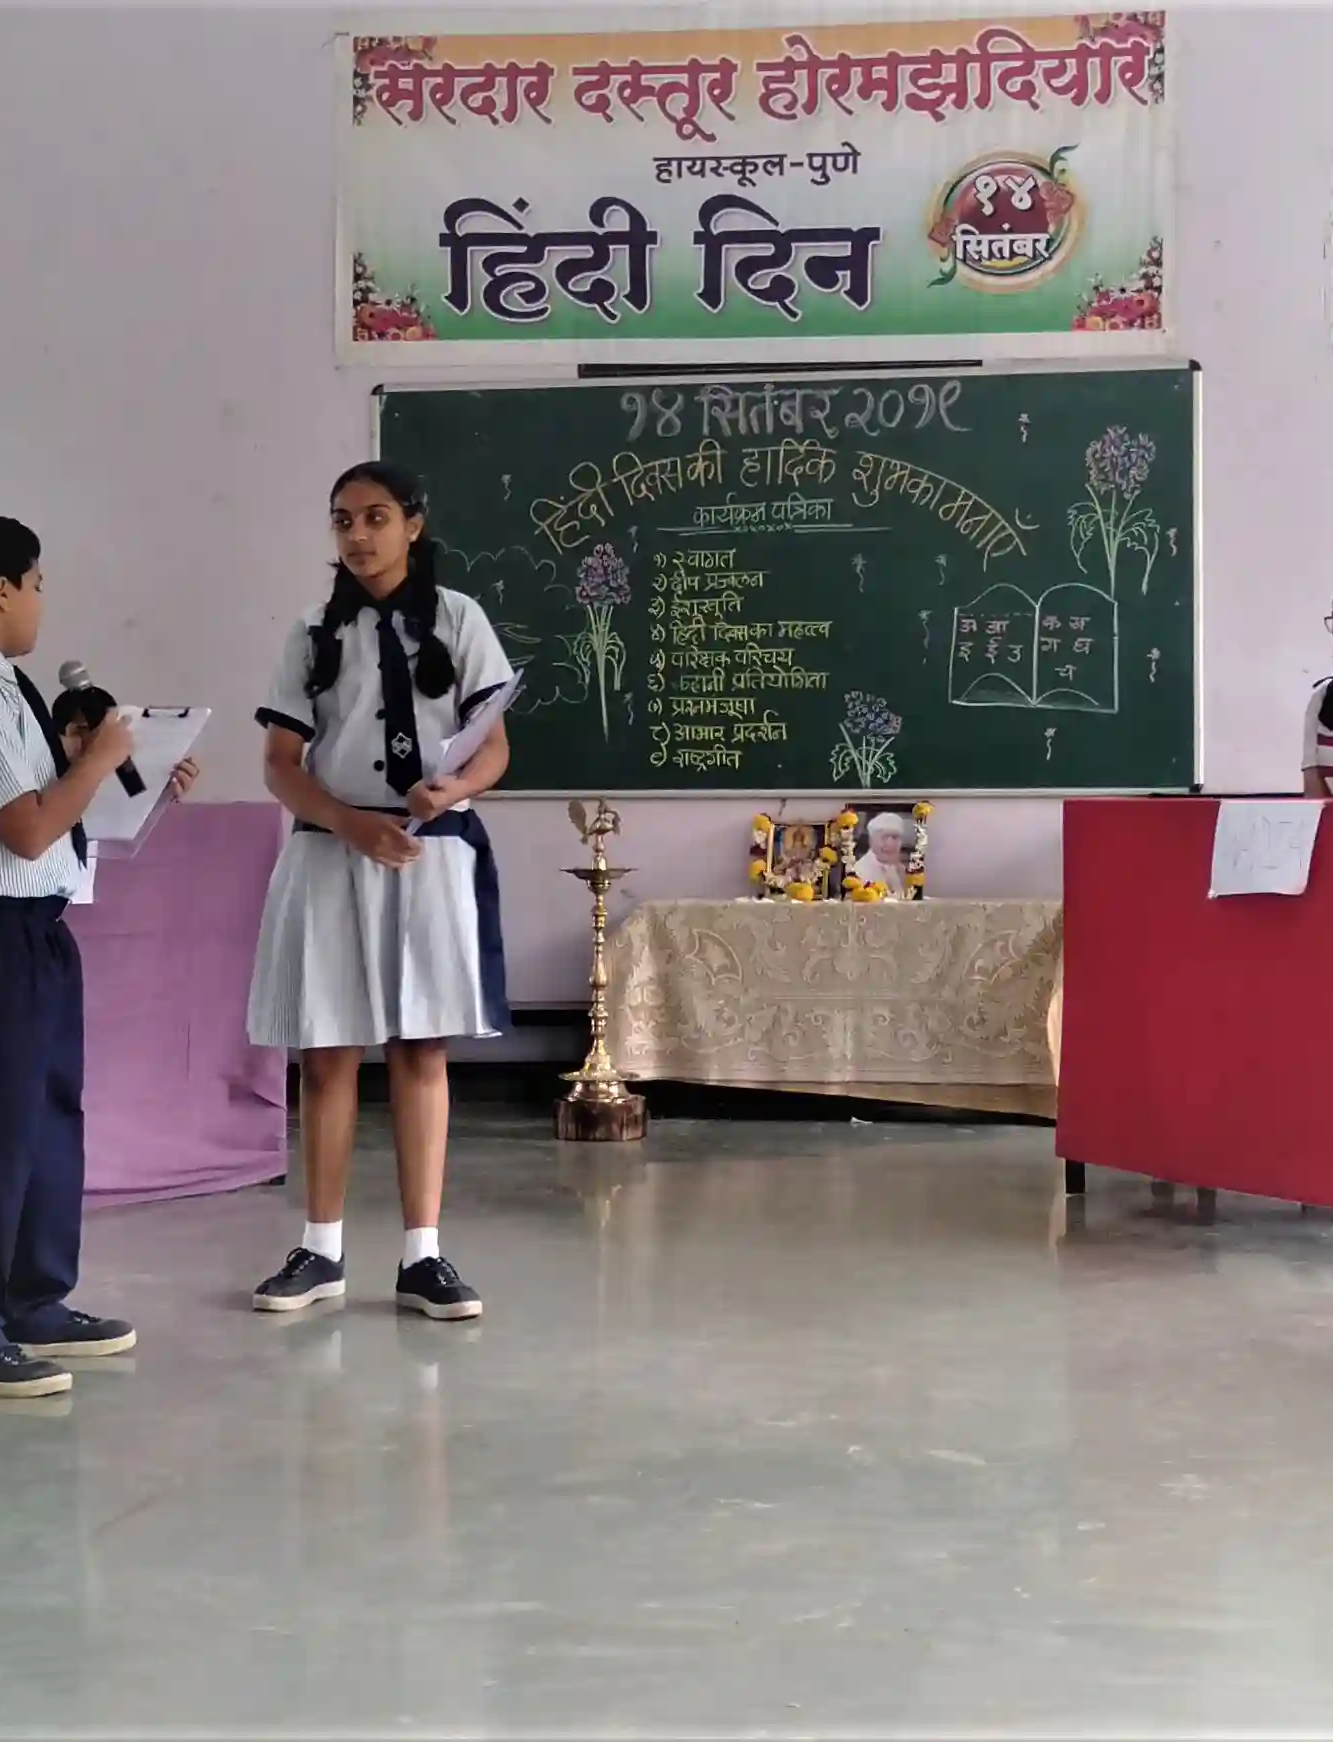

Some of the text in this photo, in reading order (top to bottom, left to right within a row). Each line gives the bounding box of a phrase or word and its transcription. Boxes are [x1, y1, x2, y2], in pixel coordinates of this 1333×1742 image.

[371, 29, 1156, 142] सरदार दस्तूर होरमझदियार
[654, 142, 861, 187] हायस्कूल-पुणे
[974, 173, 1037, 217] १४
[439, 193, 883, 324] हिंदी दिन
[952, 222, 1054, 261] सितंबर
[620, 379, 974, 442] १४ सितंबर २०१९
[530, 461, 615, 555] हिंदी
[693, 491, 835, 528] कार्यक्रम पत्रिका
[672, 548, 737, 573] स्वागत
[1042, 615, 1062, 631] क
[731, 665, 831, 691] प्रतियोगिता
[730, 709, 789, 743] प्रदर्शन
